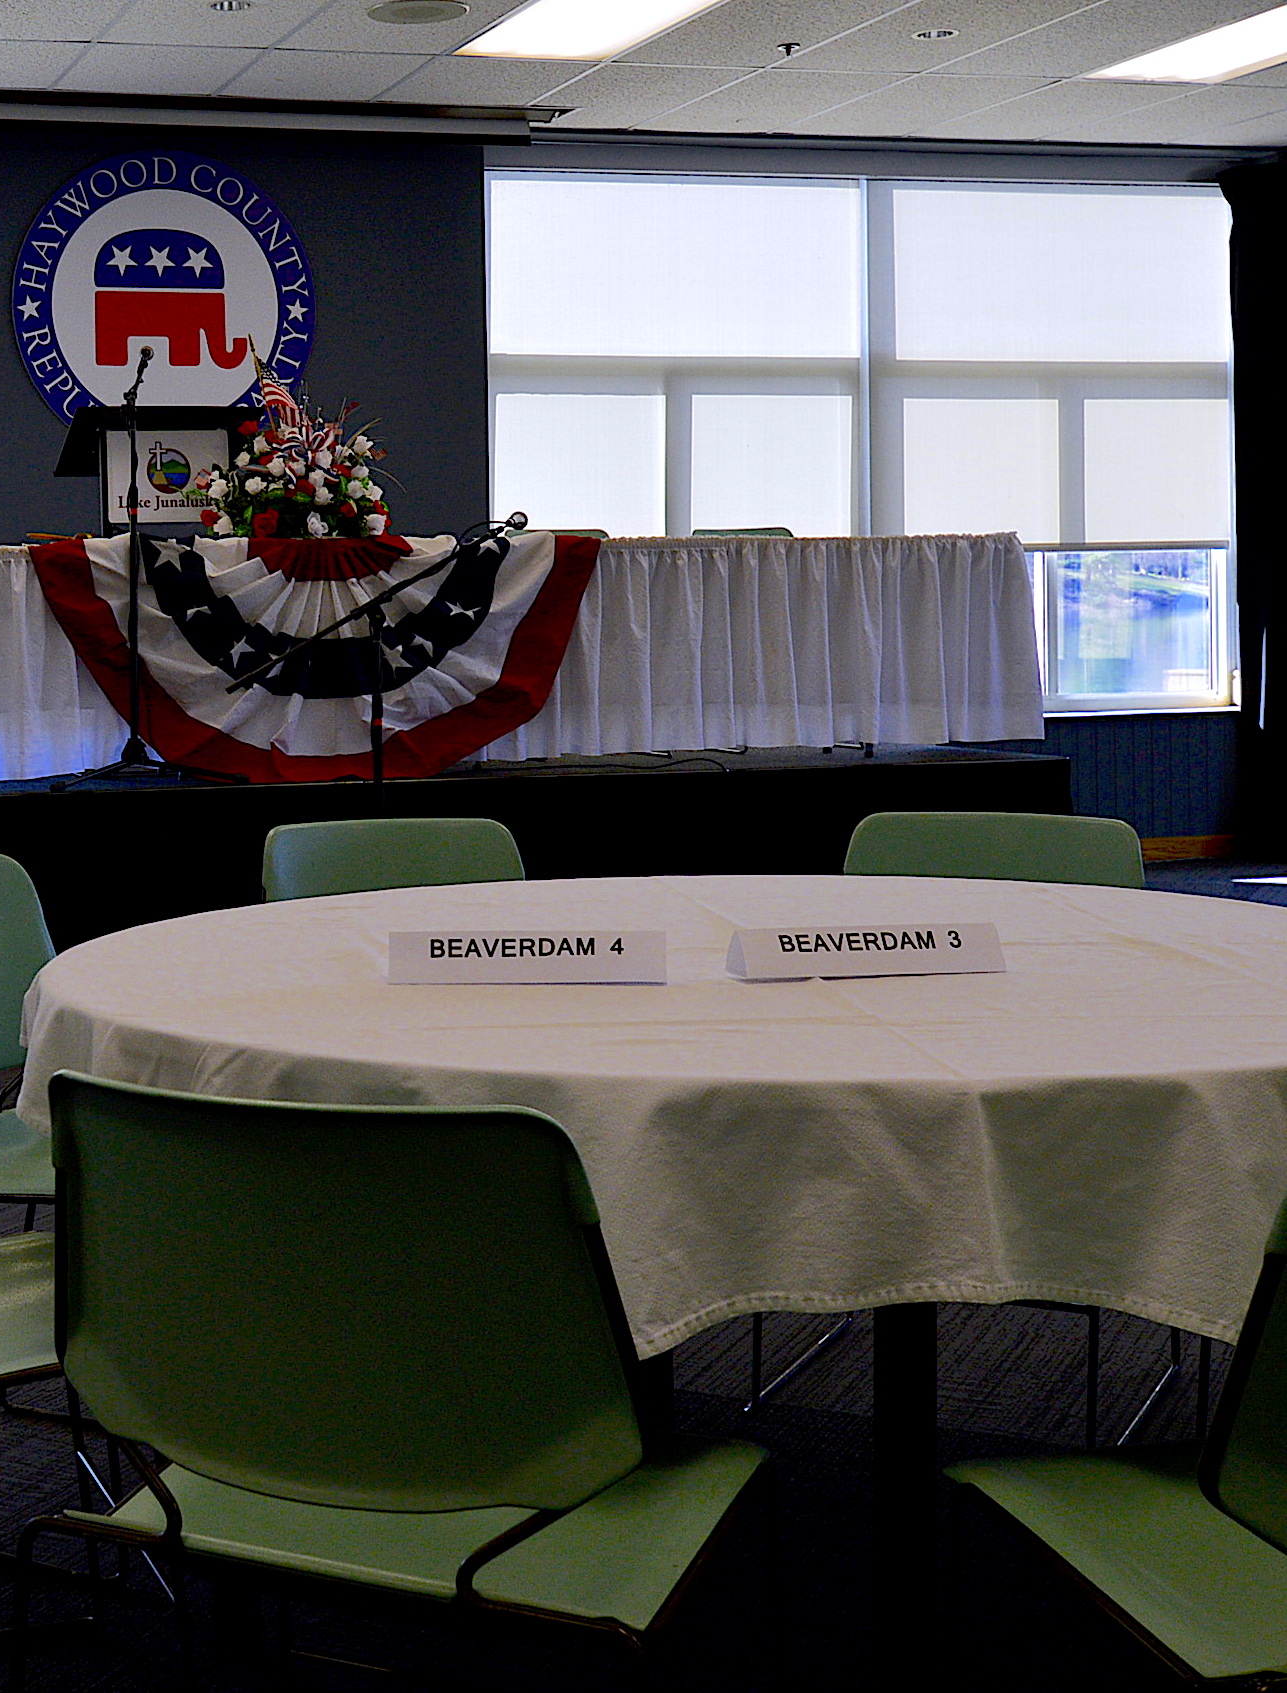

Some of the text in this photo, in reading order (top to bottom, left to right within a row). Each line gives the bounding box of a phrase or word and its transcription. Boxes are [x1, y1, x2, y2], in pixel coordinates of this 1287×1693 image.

[19, 157, 309, 298] HAYWOOD COUNTY
[22, 324, 99, 419] REPU
[118, 495, 214, 512] Lke Junalusk
[429, 937, 625, 958] BEAVERDAM 4
[778, 930, 962, 952] BEAVERDAM 3
